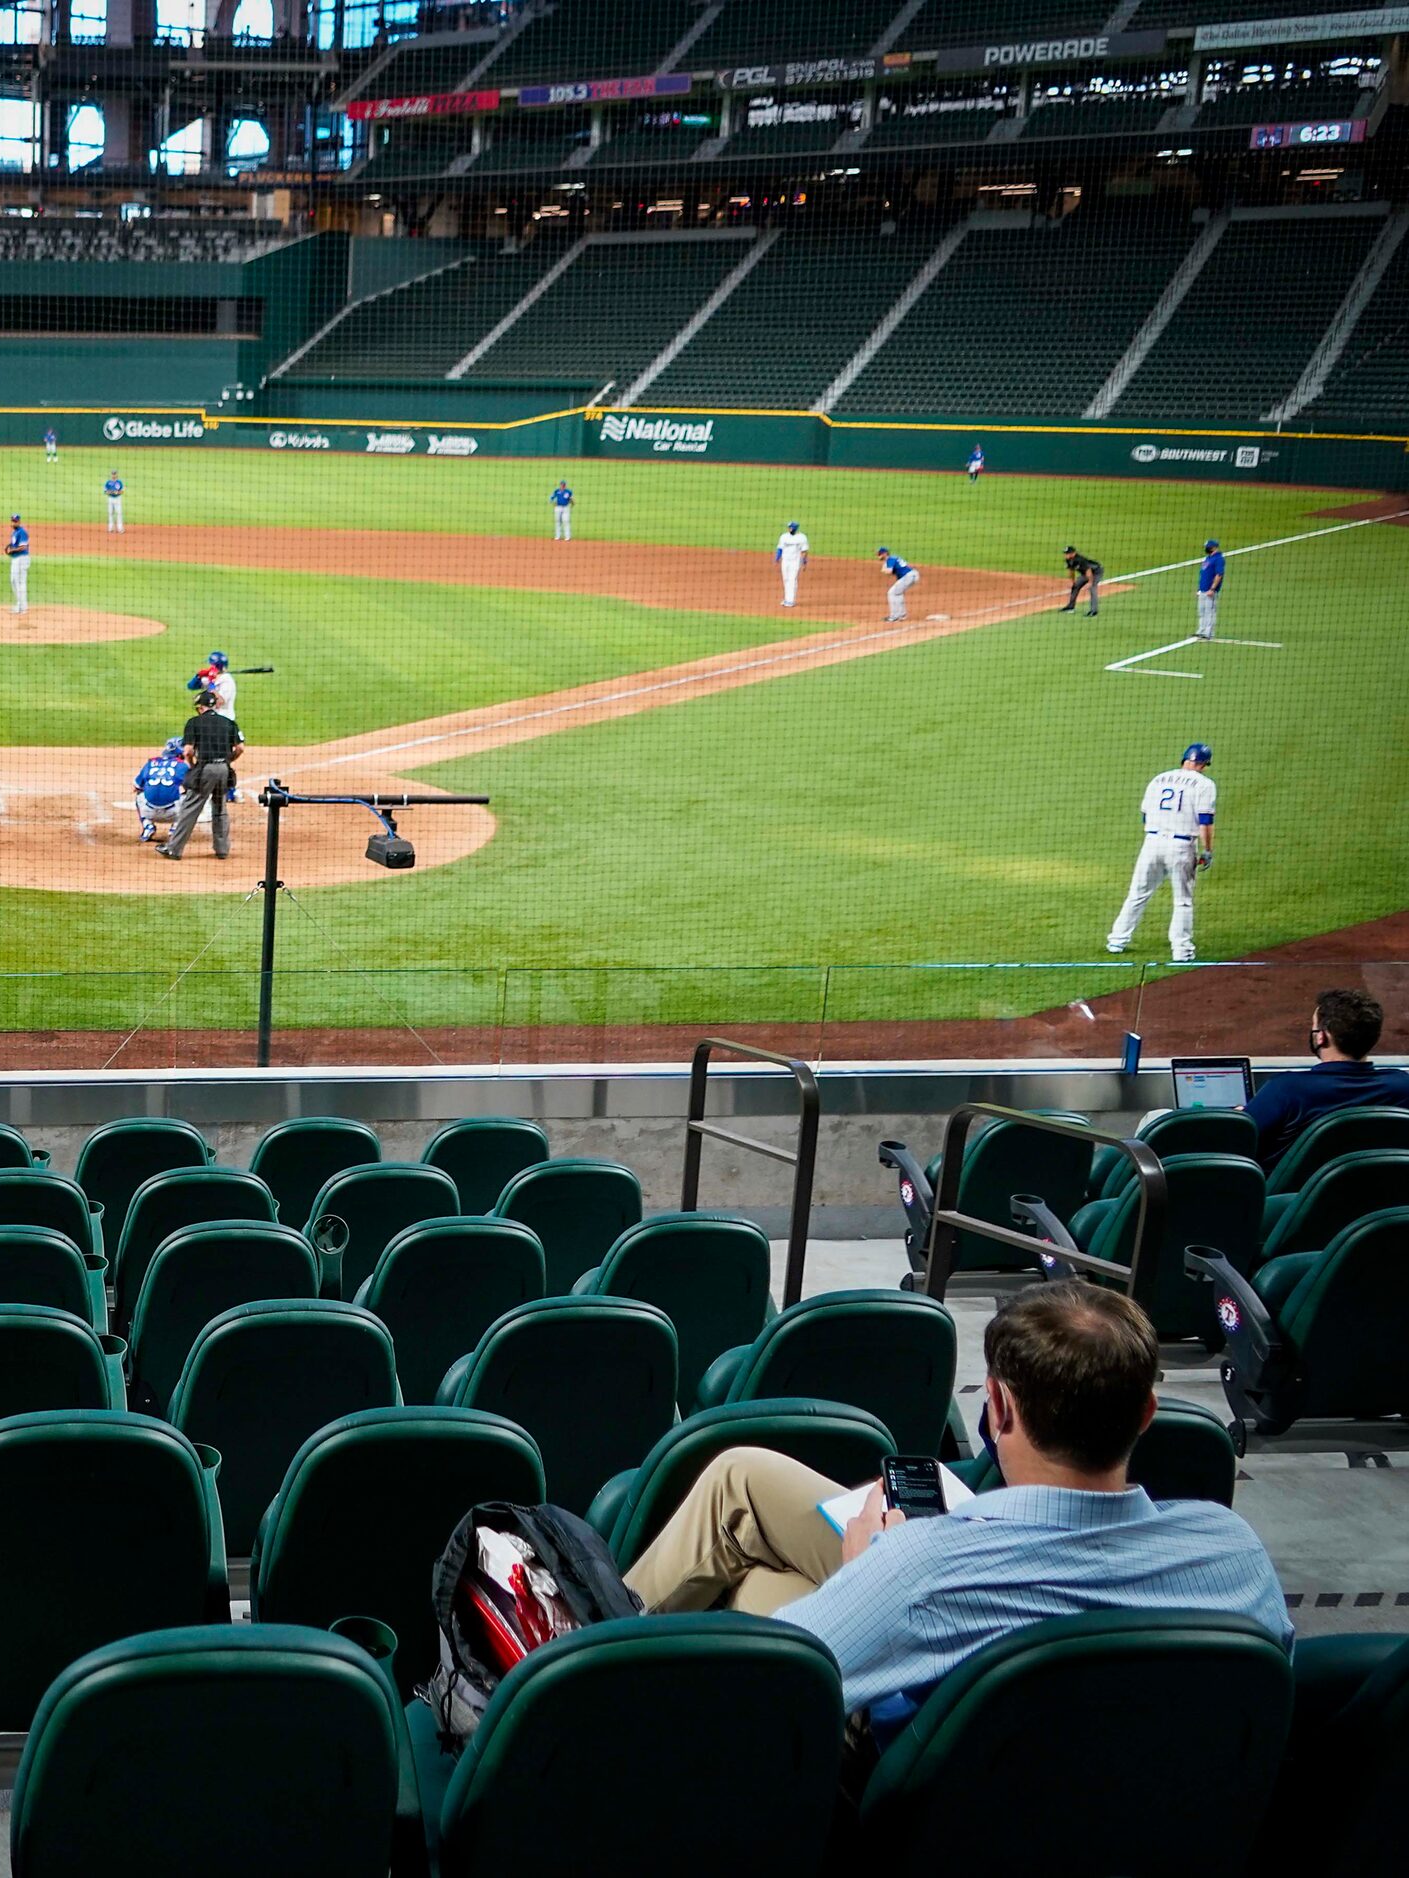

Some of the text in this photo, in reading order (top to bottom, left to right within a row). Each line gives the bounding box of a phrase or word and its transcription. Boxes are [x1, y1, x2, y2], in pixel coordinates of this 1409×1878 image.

[984, 37, 1109, 66] POWERADE
[732, 66, 776, 86] PGL
[1300, 125, 1340, 142] 6:23
[125, 419, 204, 438] Globe Life
[653, 441, 672, 452] Car
[1160, 447, 1228, 462] SOUTHWEST
[1159, 788, 1184, 812] 21
